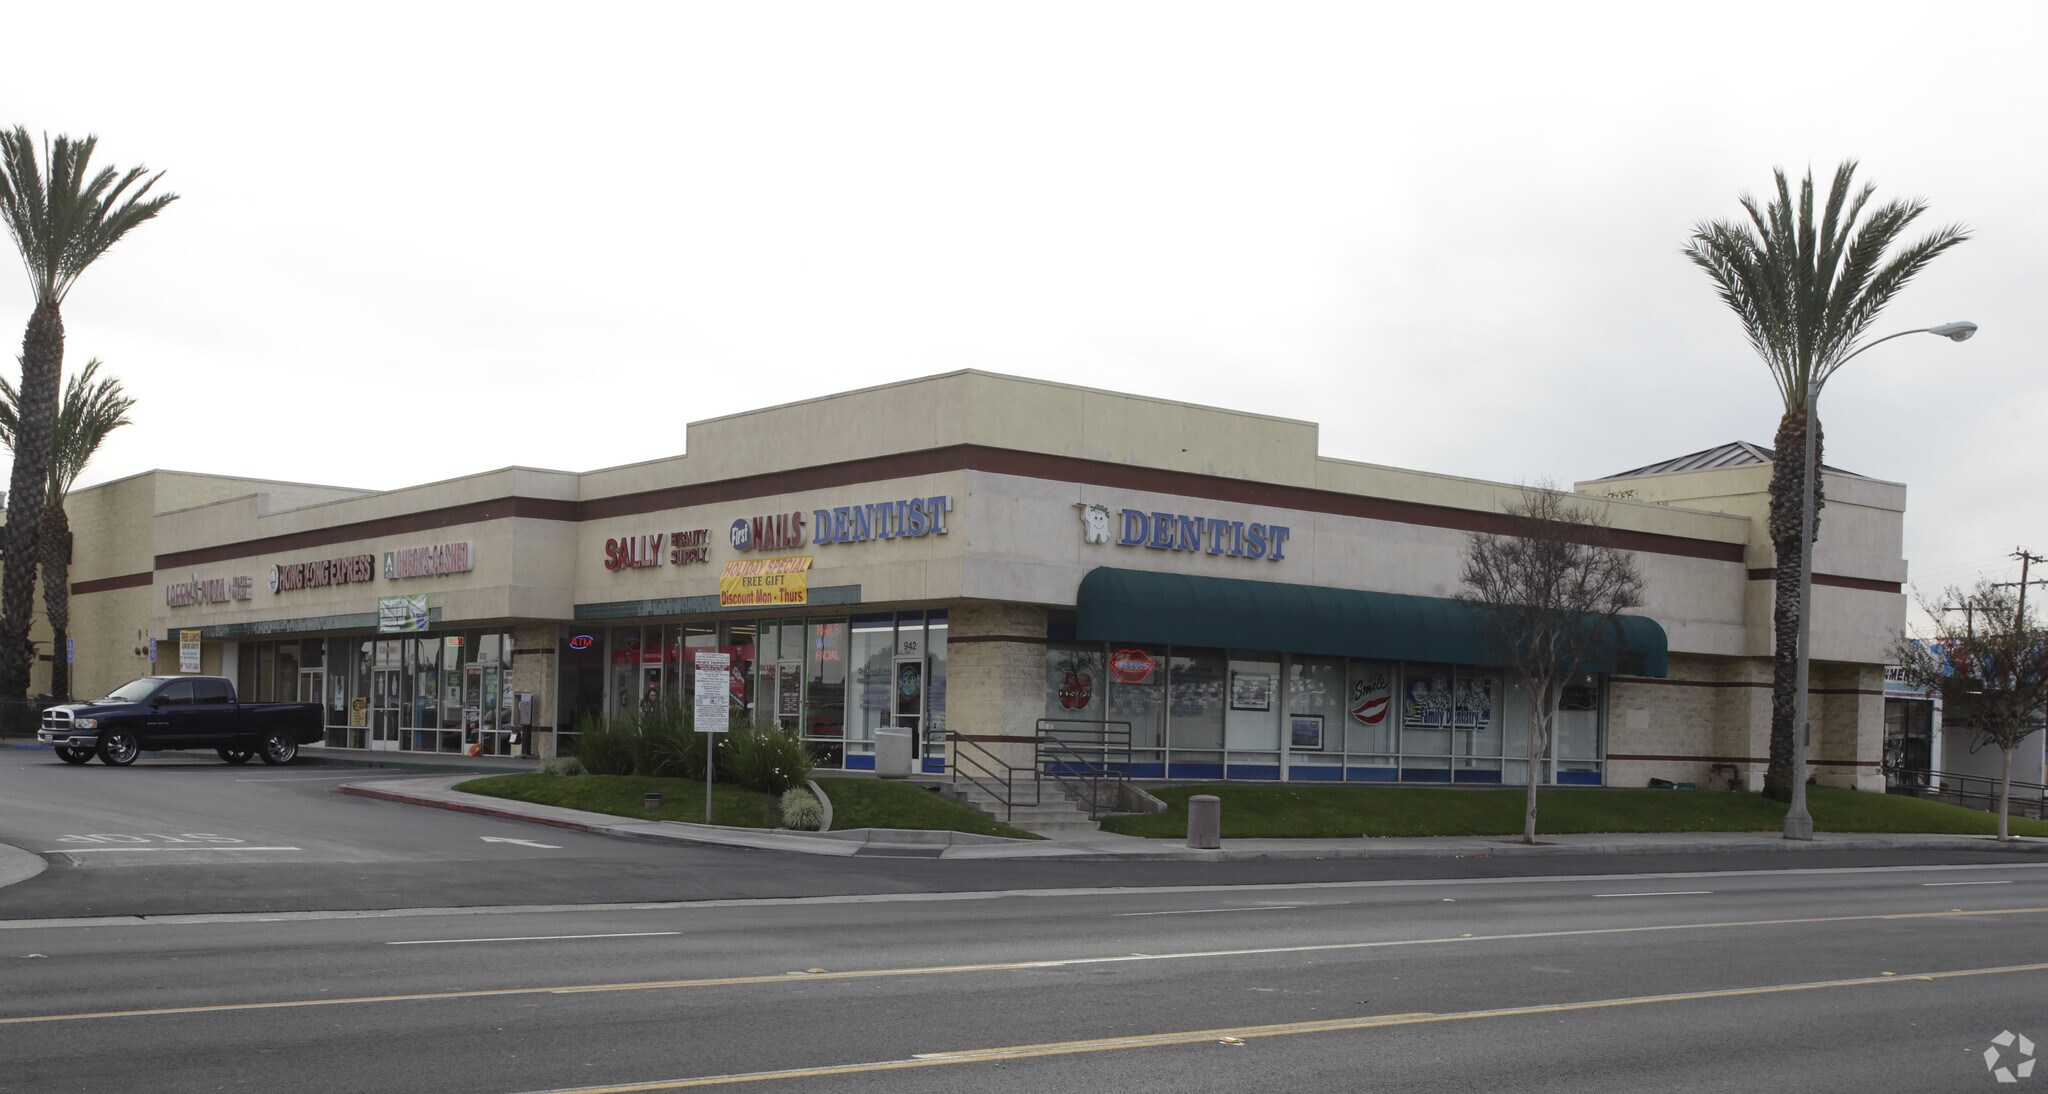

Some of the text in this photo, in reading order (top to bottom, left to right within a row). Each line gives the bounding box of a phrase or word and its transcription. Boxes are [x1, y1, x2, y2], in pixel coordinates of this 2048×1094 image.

[812, 496, 950, 545] DENTIST
[671, 529, 709, 547] BEAUTY
[731, 511, 805, 550] First NAILS
[1118, 508, 1290, 561] DENTIST
[396, 542, 470, 578] CHECKS CASHED
[605, 534, 665, 571] SALLY
[671, 548, 709, 565] SUPPLY
[280, 554, 373, 591] HONG KONG EXPRESS
[723, 558, 807, 577] HOLIDAY SPECIAL
[742, 575, 785, 587] FREE GIFT
[721, 590, 754, 606] Discount
[756, 589, 772, 604] Mon
[779, 588, 803, 603] Thurs
[571, 638, 592, 647] ATM
[904, 642, 917, 651] 942
[816, 650, 839, 660] FACIAL
[1354, 673, 1391, 701] Smile
[1420, 707, 1444, 727] Family
